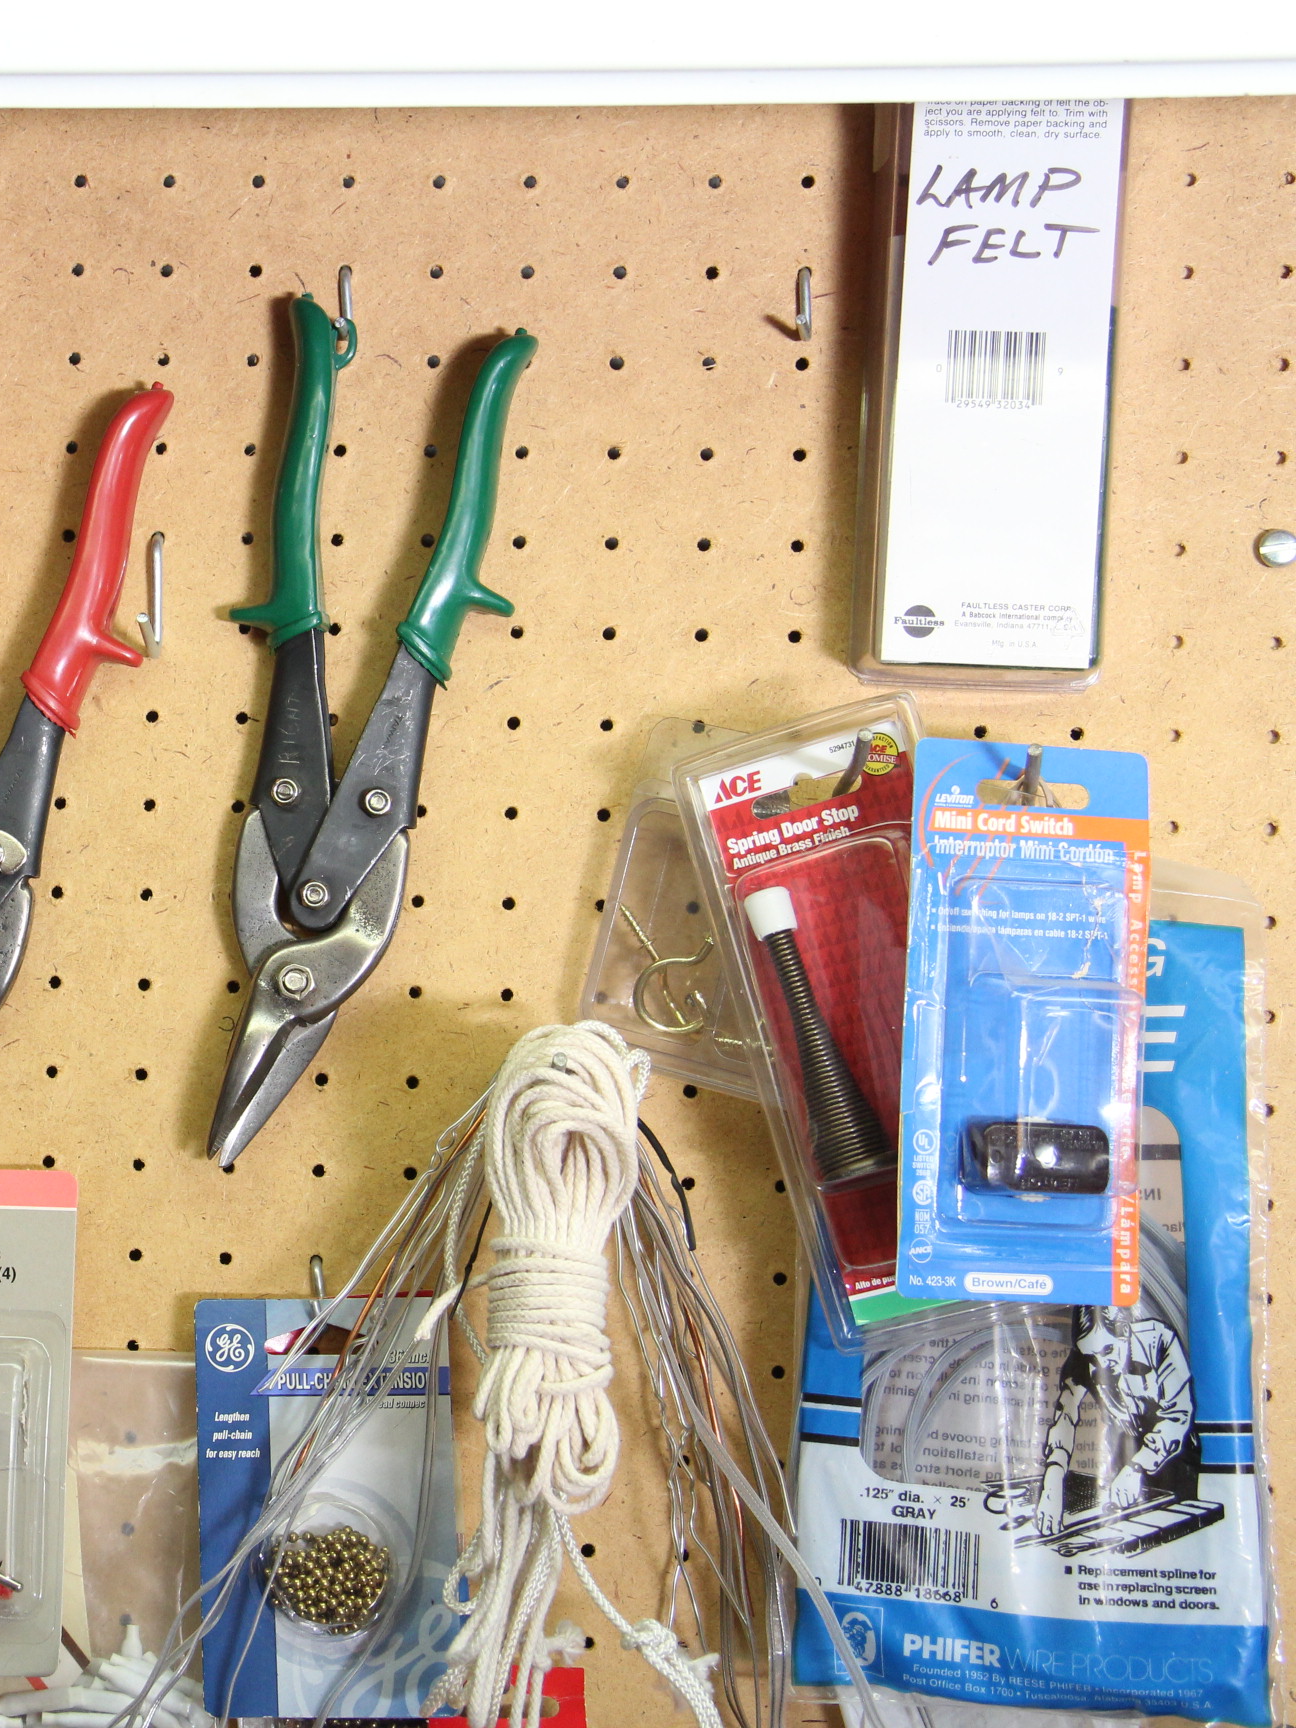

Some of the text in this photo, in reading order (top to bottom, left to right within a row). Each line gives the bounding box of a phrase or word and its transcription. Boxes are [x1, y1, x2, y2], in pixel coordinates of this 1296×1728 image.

[924, 107, 942, 117] ject
[946, 109, 963, 118] you
[985, 108, 1026, 118] applying
[1031, 108, 1045, 117] felt
[1065, 109, 1084, 117] Trim
[1088, 109, 1107, 117] with
[916, 164, 1082, 208] LAMP
[928, 224, 1100, 266] FELT
[956, 399, 1031, 409] 29549 32034
[894, 616, 945, 626] Faultless
[714, 771, 762, 804] ACE
[727, 804, 859, 855] Spring Door Stop
[934, 811, 1074, 836] Mini Cord Switch
[733, 826, 850, 870] Antique Brass Finish
[934, 835, 1016, 859] Interruptor
[1020, 840, 1054, 860] Mini
[910, 1275, 1046, 1290] No. 423-3K Brown/Café
[215, 1412, 250, 1423] Lengthen
[213, 1430, 252, 1442] pull-chain
[206, 1448, 260, 1460] for easy reach
[860, 1486, 970, 1508] .125" dia. 25'
[892, 1505, 936, 1520] GRAY
[855, 1581, 961, 1603] 47888 18668
[903, 1634, 1213, 1683] PHIFER WIRE PRODUCTS
